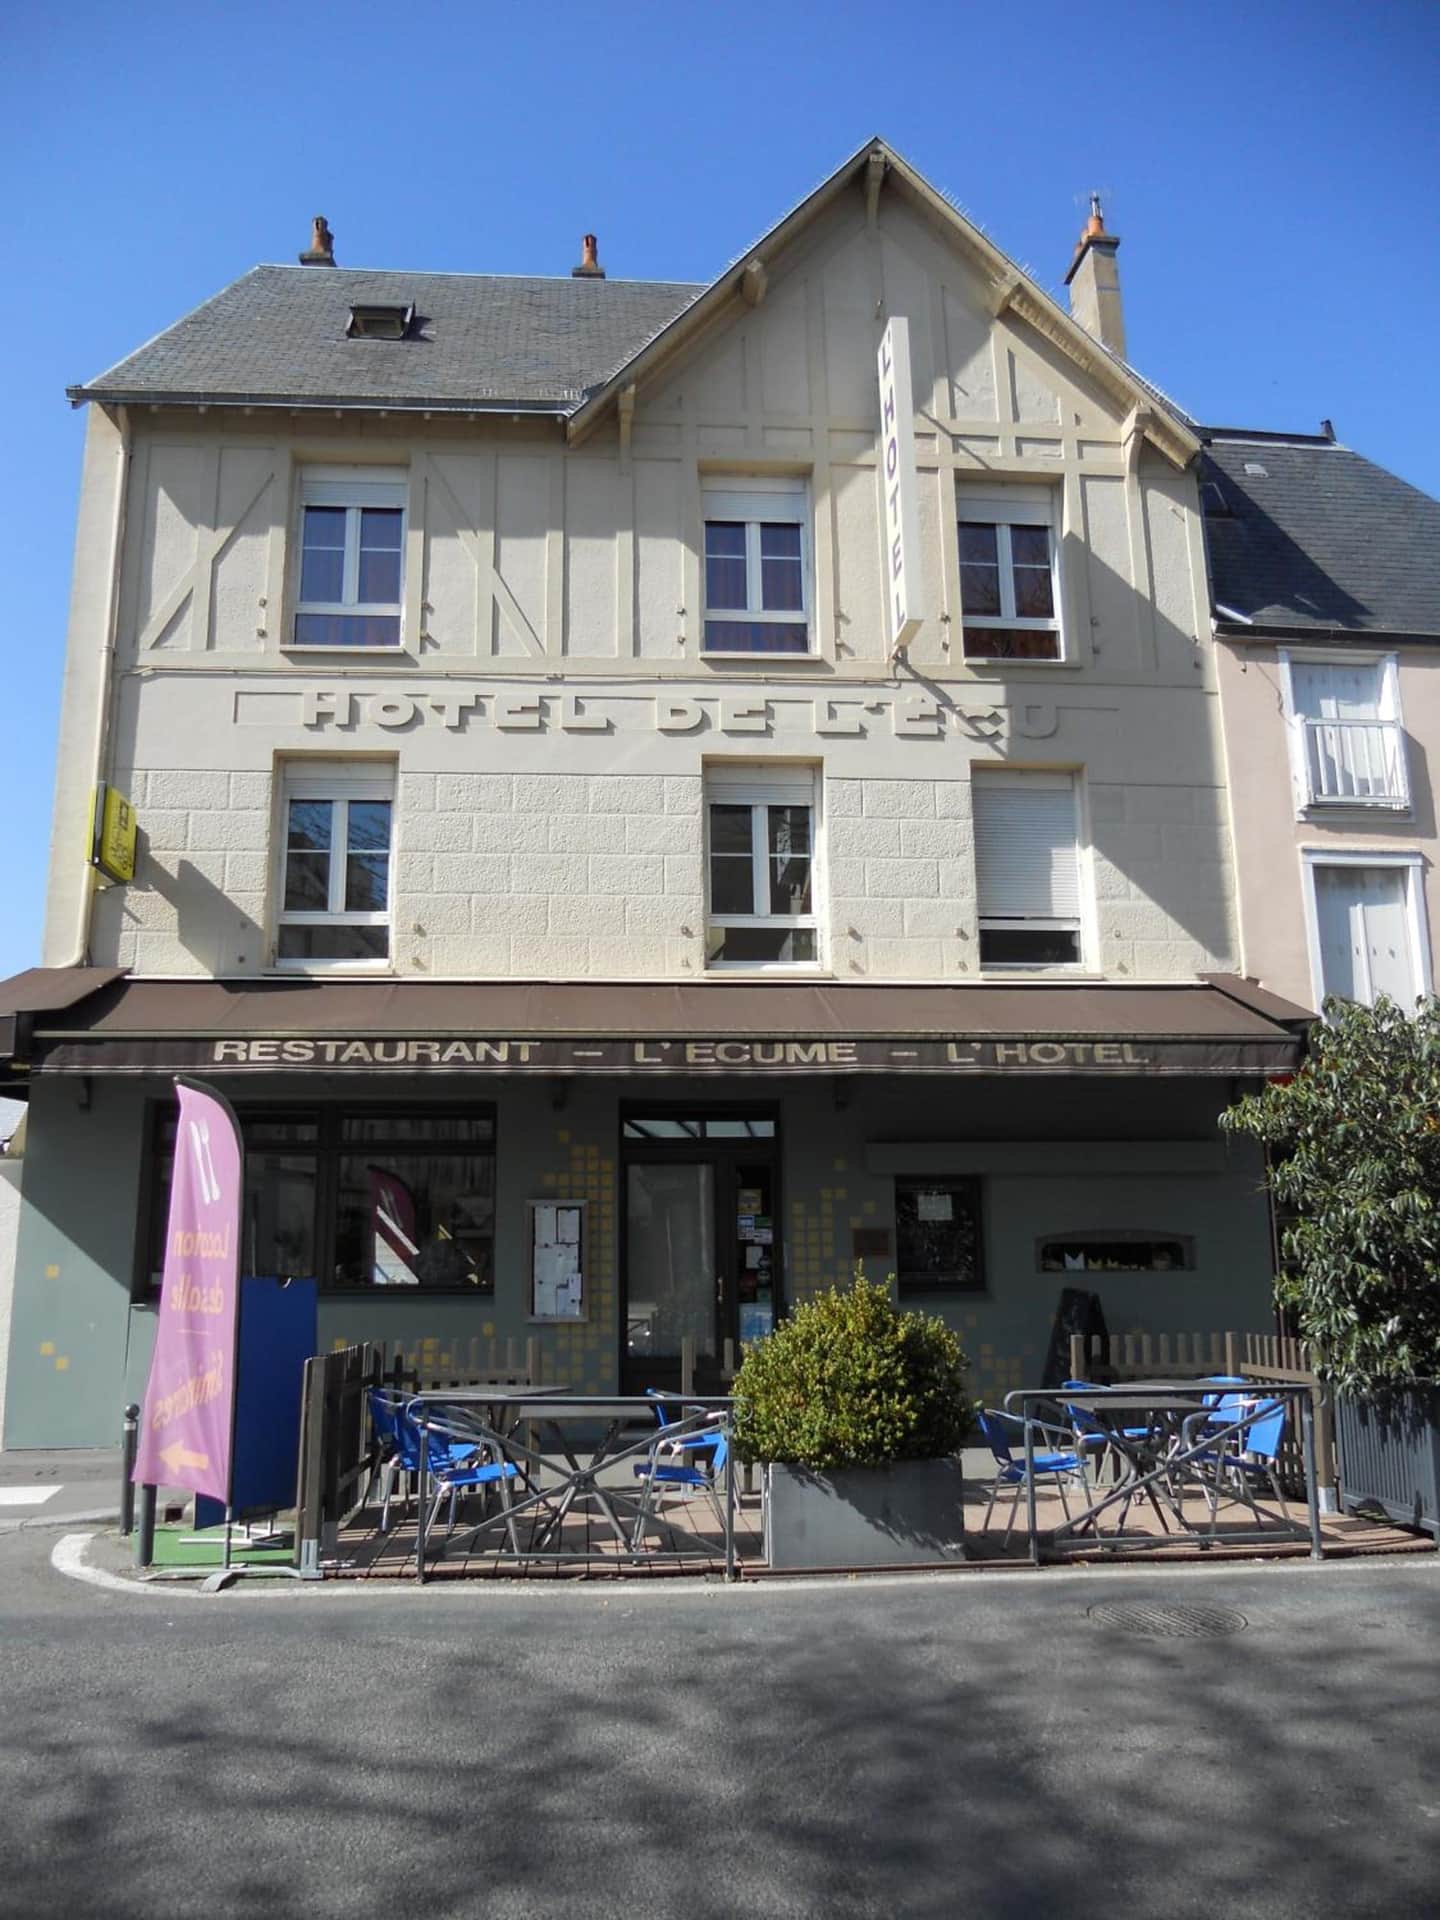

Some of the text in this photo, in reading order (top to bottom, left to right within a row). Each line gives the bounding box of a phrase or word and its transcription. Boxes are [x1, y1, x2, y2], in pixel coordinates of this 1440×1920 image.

[303, 691, 609, 731] HOTEL
[656, 696, 768, 734] DE
[213, 1040, 541, 1063] RESTAURANT
